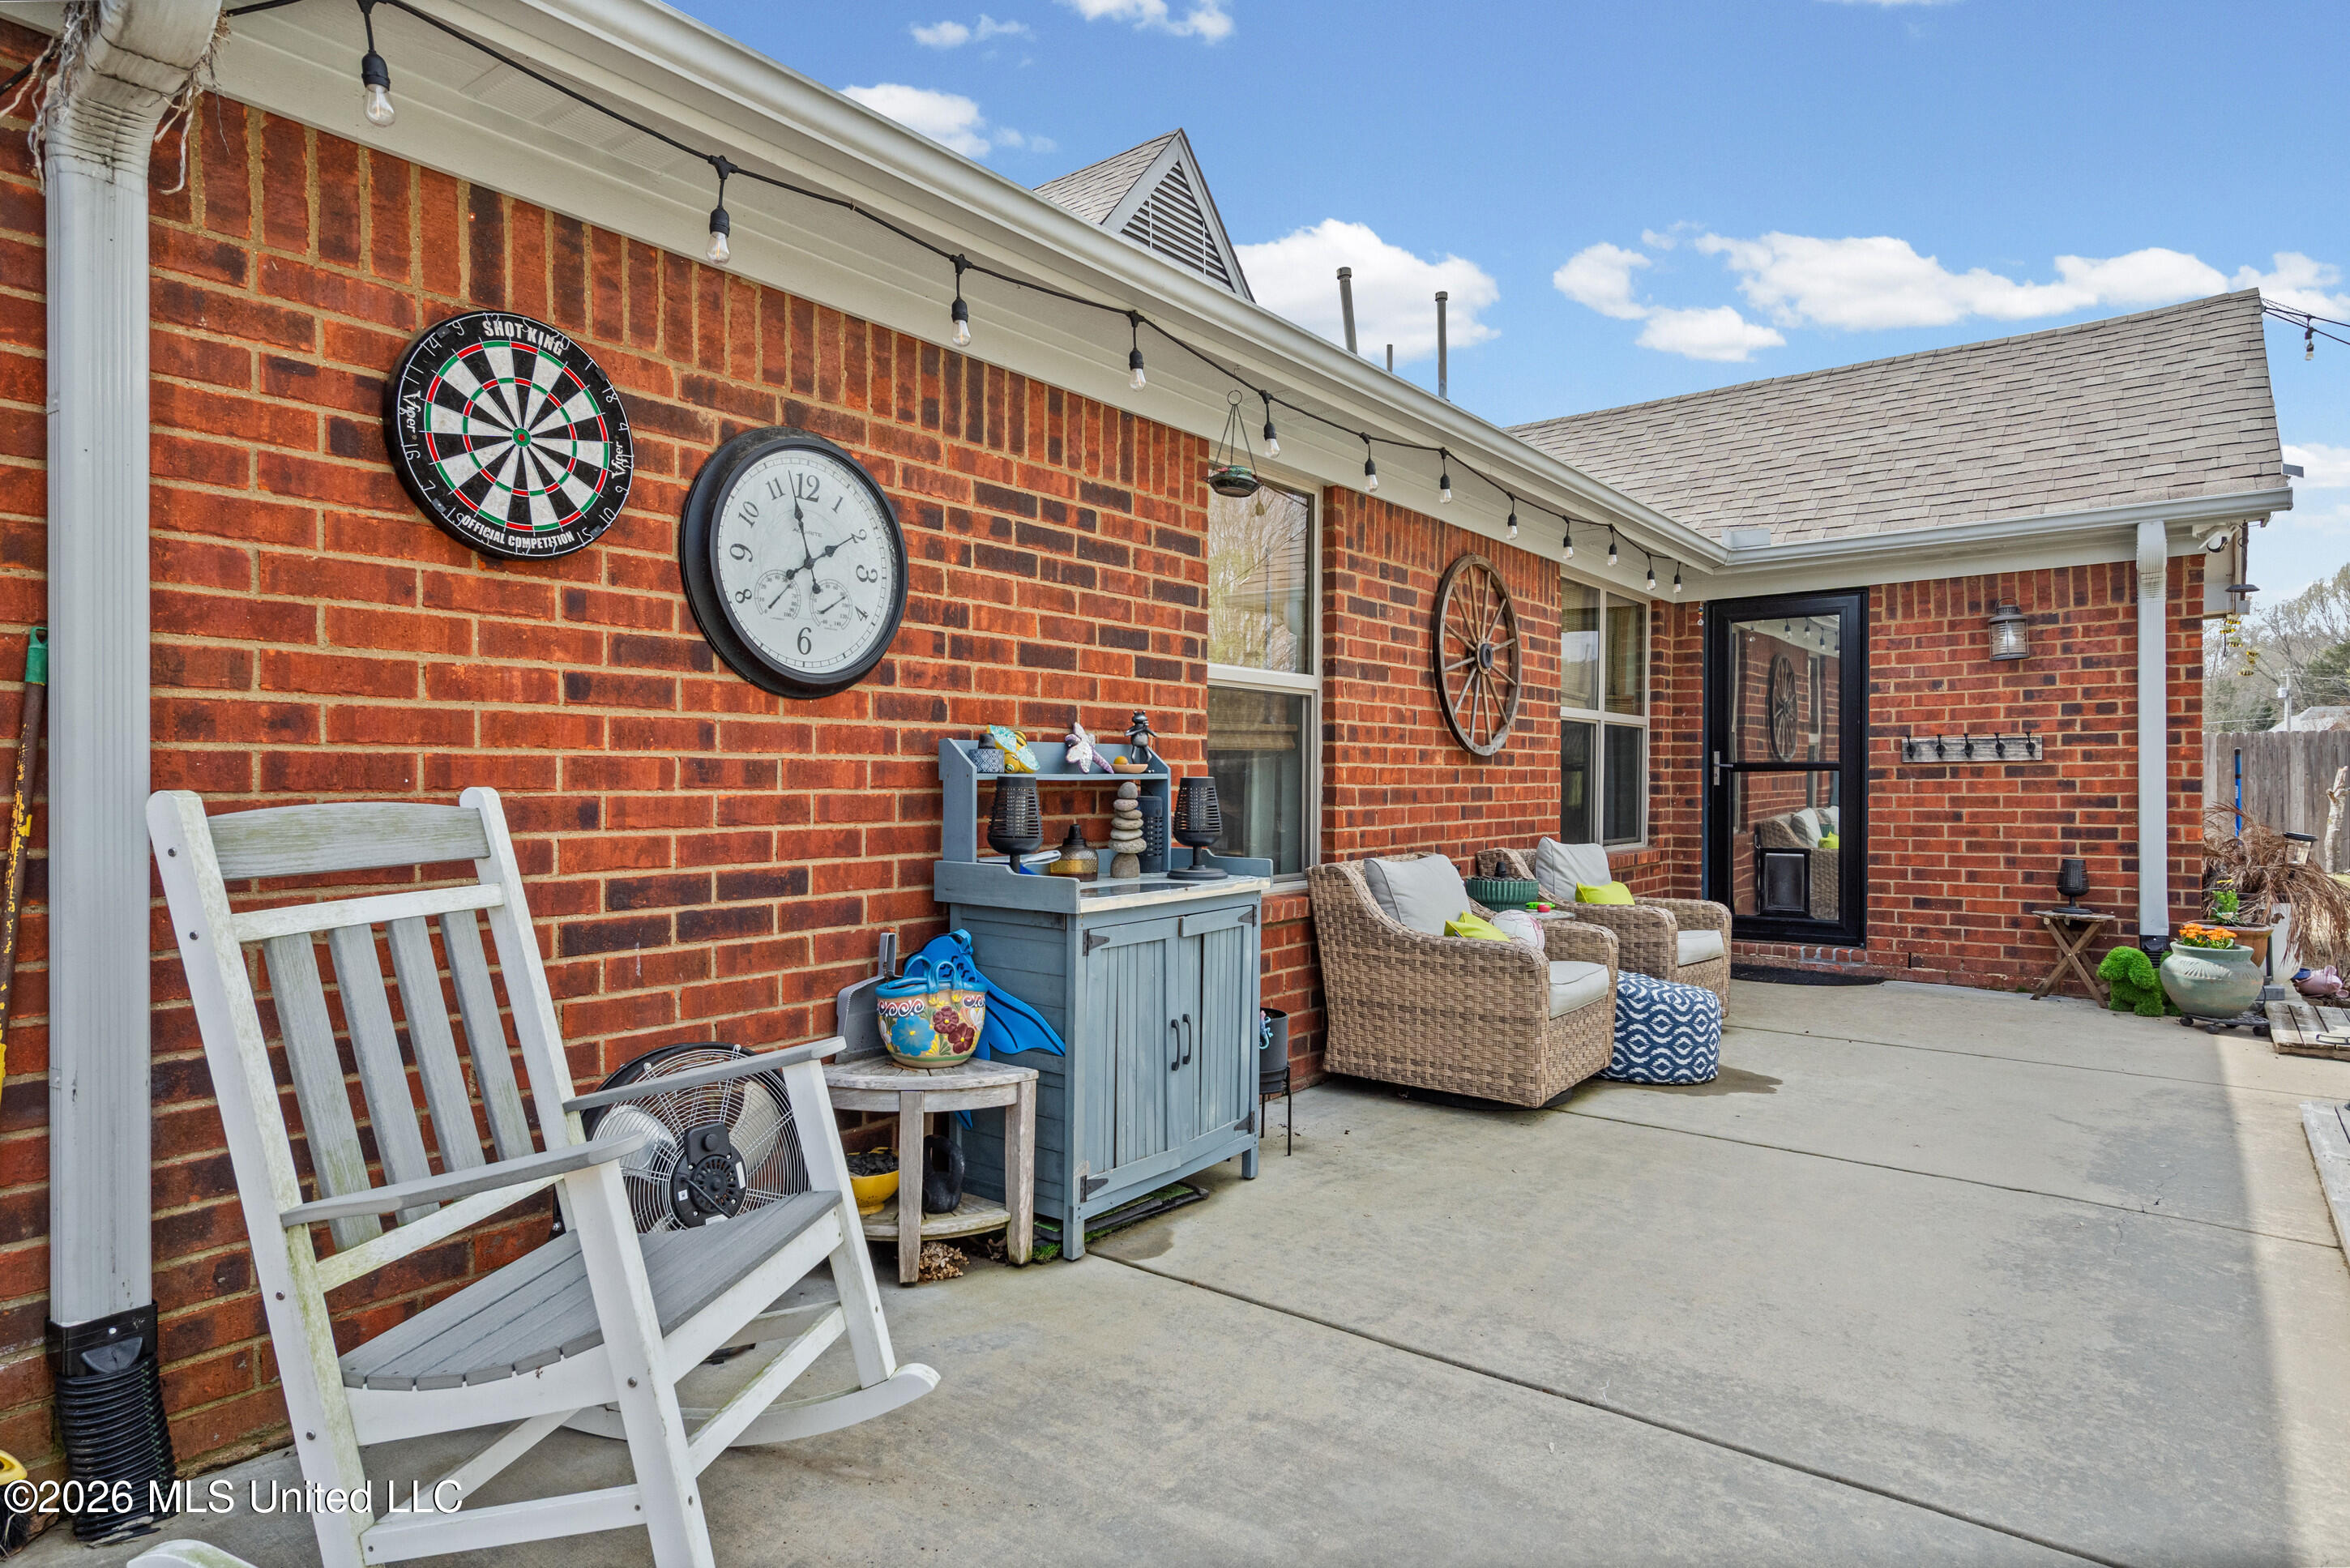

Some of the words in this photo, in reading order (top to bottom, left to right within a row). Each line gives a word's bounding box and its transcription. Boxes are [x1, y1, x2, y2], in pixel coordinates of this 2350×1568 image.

[482, 320, 524, 340] SHOT
[527, 326, 564, 357] KING
[765, 476, 786, 501] 11
[795, 472, 821, 503] 12
[737, 501, 759, 528] 10
[831, 496, 844, 514] 1
[462, 515, 506, 545] OFFICIAL
[507, 530, 575, 549] COMPETITION
[850, 528, 868, 545] 2
[728, 542, 754, 563] 9
[856, 564, 879, 584] 3
[734, 588, 753, 605] 8
[854, 605, 870, 622] 4
[797, 627, 813, 655] 6
